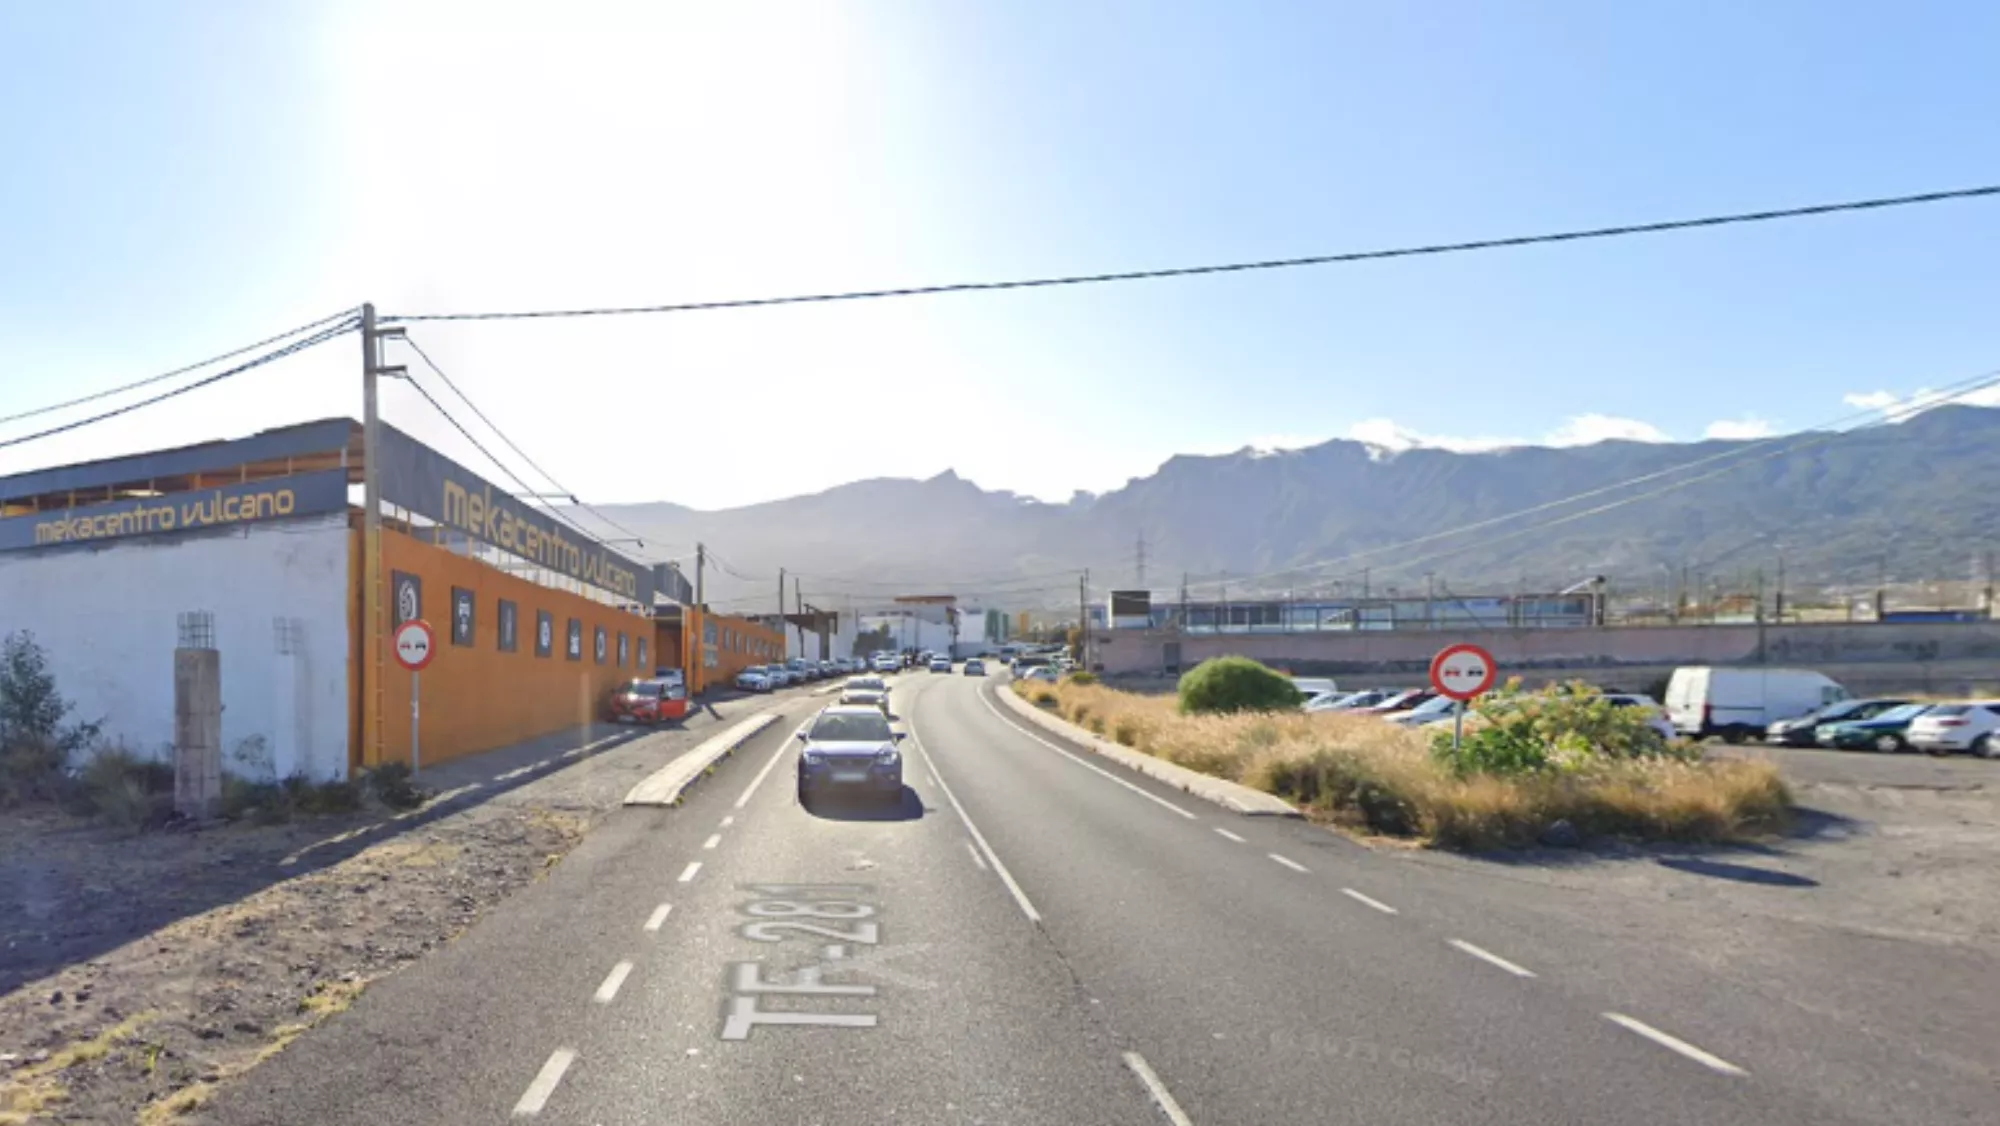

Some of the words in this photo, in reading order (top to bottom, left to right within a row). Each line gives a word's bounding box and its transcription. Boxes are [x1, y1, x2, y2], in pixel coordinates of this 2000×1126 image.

[34, 504, 175, 545] mekacentro
[181, 489, 294, 527] vulcano
[441, 478, 579, 576] mekacentro
[582, 549, 637, 598] vulcano
